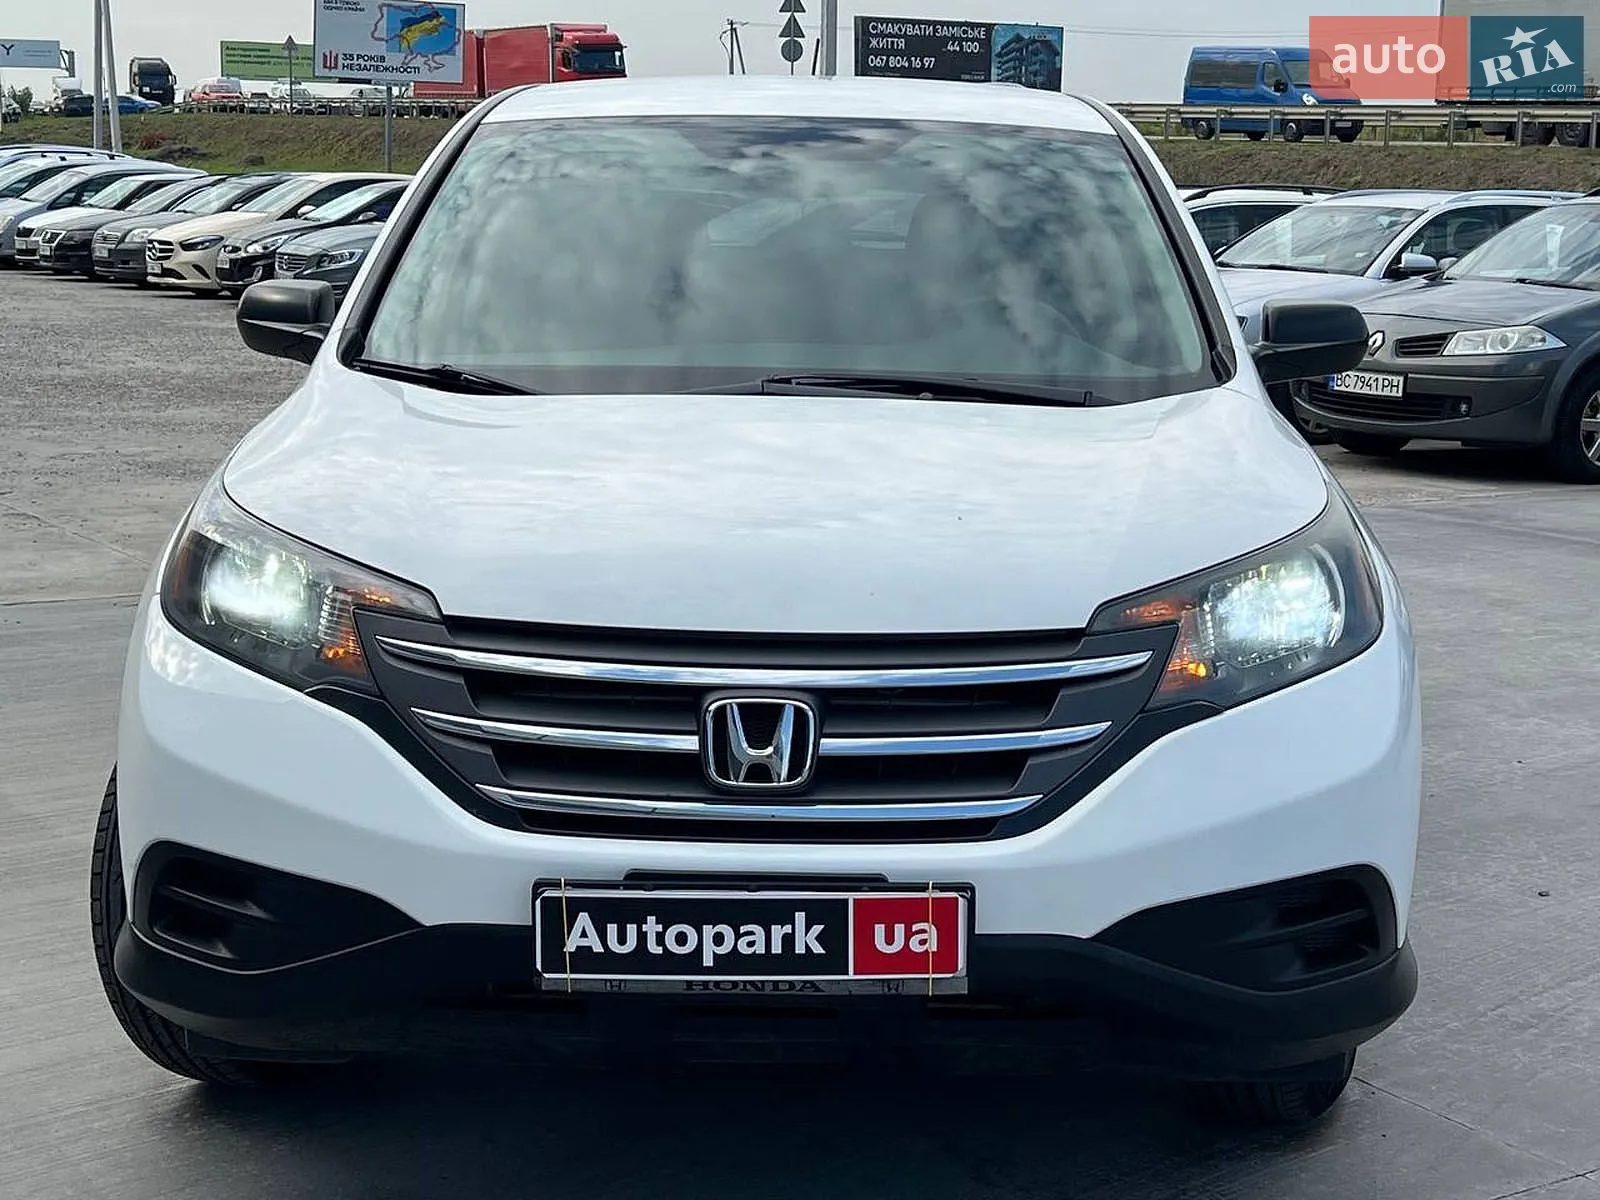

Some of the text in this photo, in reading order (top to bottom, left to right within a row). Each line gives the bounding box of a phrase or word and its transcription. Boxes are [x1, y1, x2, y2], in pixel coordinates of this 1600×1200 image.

[869, 22, 986, 39] СМАКУВАТИ ЗАМІСЬКЕ
[869, 37, 905, 49] ЖИТТЯ
[947, 41, 980, 53] 44 100
[356, 54, 386, 63] РОКІВ
[868, 55, 936, 69] 067 804 16 97
[342, 63, 420, 74] НЕЗАЛЕЖНОСТІ
[1353, 375, 1379, 392] 7941
[1381, 378, 1400, 394] PH
[564, 912, 939, 967] Autopark ua
[683, 980, 826, 993] HONDA
